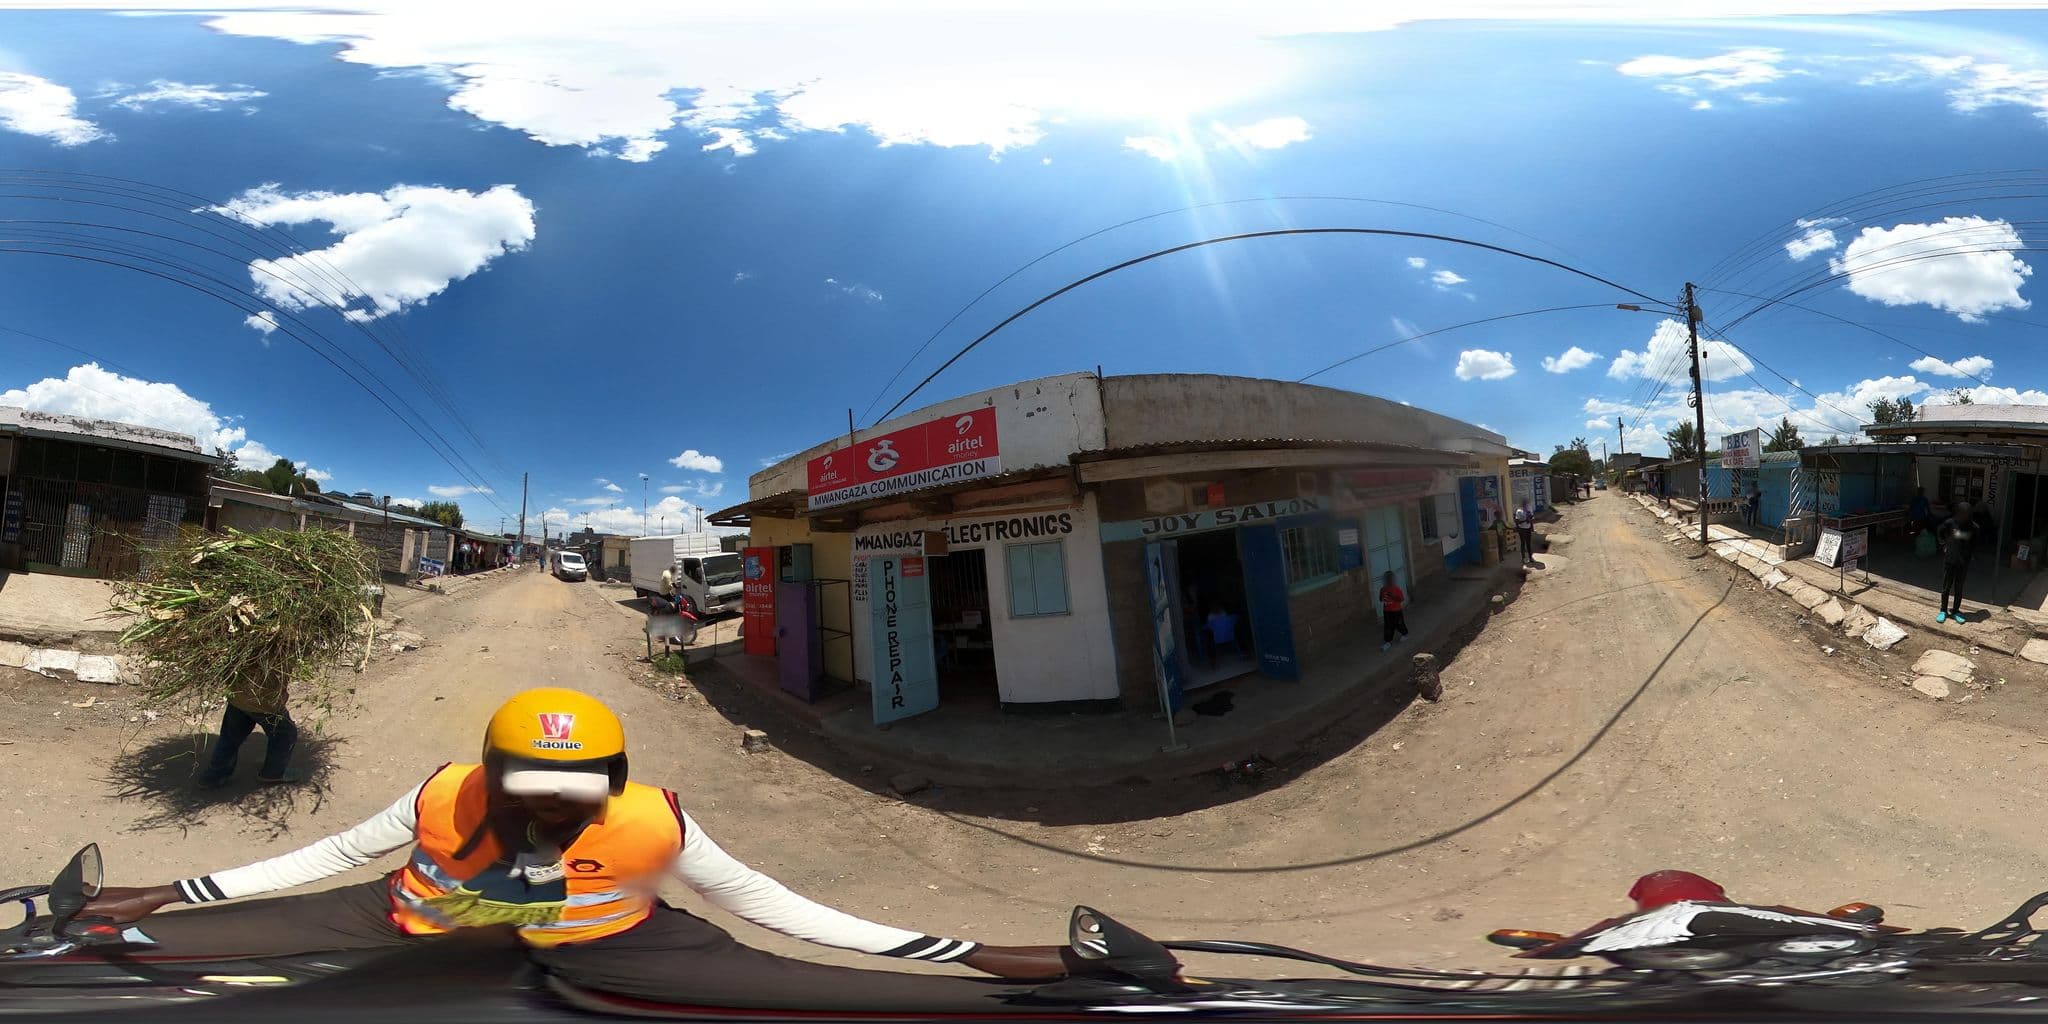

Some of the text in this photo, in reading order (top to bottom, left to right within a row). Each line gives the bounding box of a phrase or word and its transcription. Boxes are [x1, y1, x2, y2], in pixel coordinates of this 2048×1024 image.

[948, 435, 984, 454] airtel
[953, 450, 977, 461] money
[815, 460, 985, 506] MWANGAZA COMMUNICATION
[819, 470, 838, 482] airtel
[1142, 499, 1320, 535] JOY SALON
[744, 582, 774, 593] airtel
[884, 560, 905, 709] PHONE REPAIR
